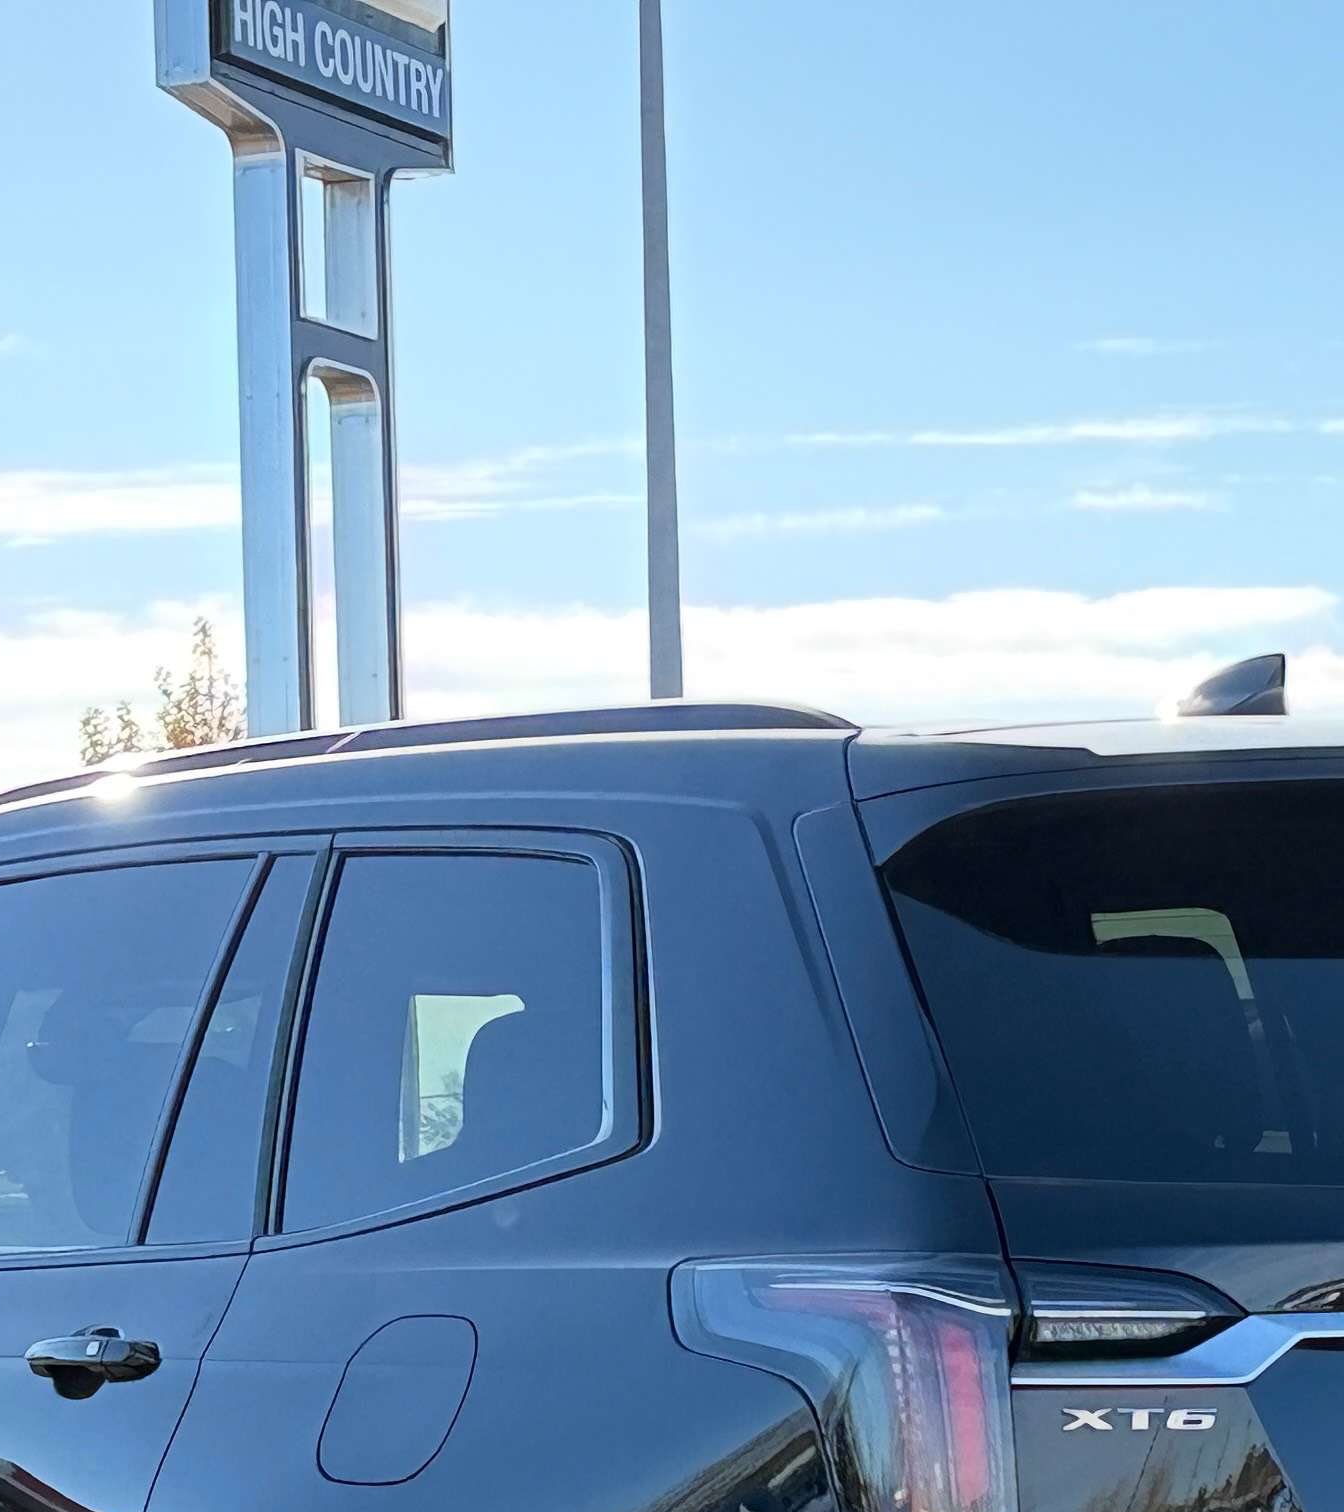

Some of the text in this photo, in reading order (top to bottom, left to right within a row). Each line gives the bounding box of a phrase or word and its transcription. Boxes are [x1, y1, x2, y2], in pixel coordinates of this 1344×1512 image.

[234, 0, 444, 118] HIGH COUNTRY
[1062, 1407, 1218, 1431] XT6
